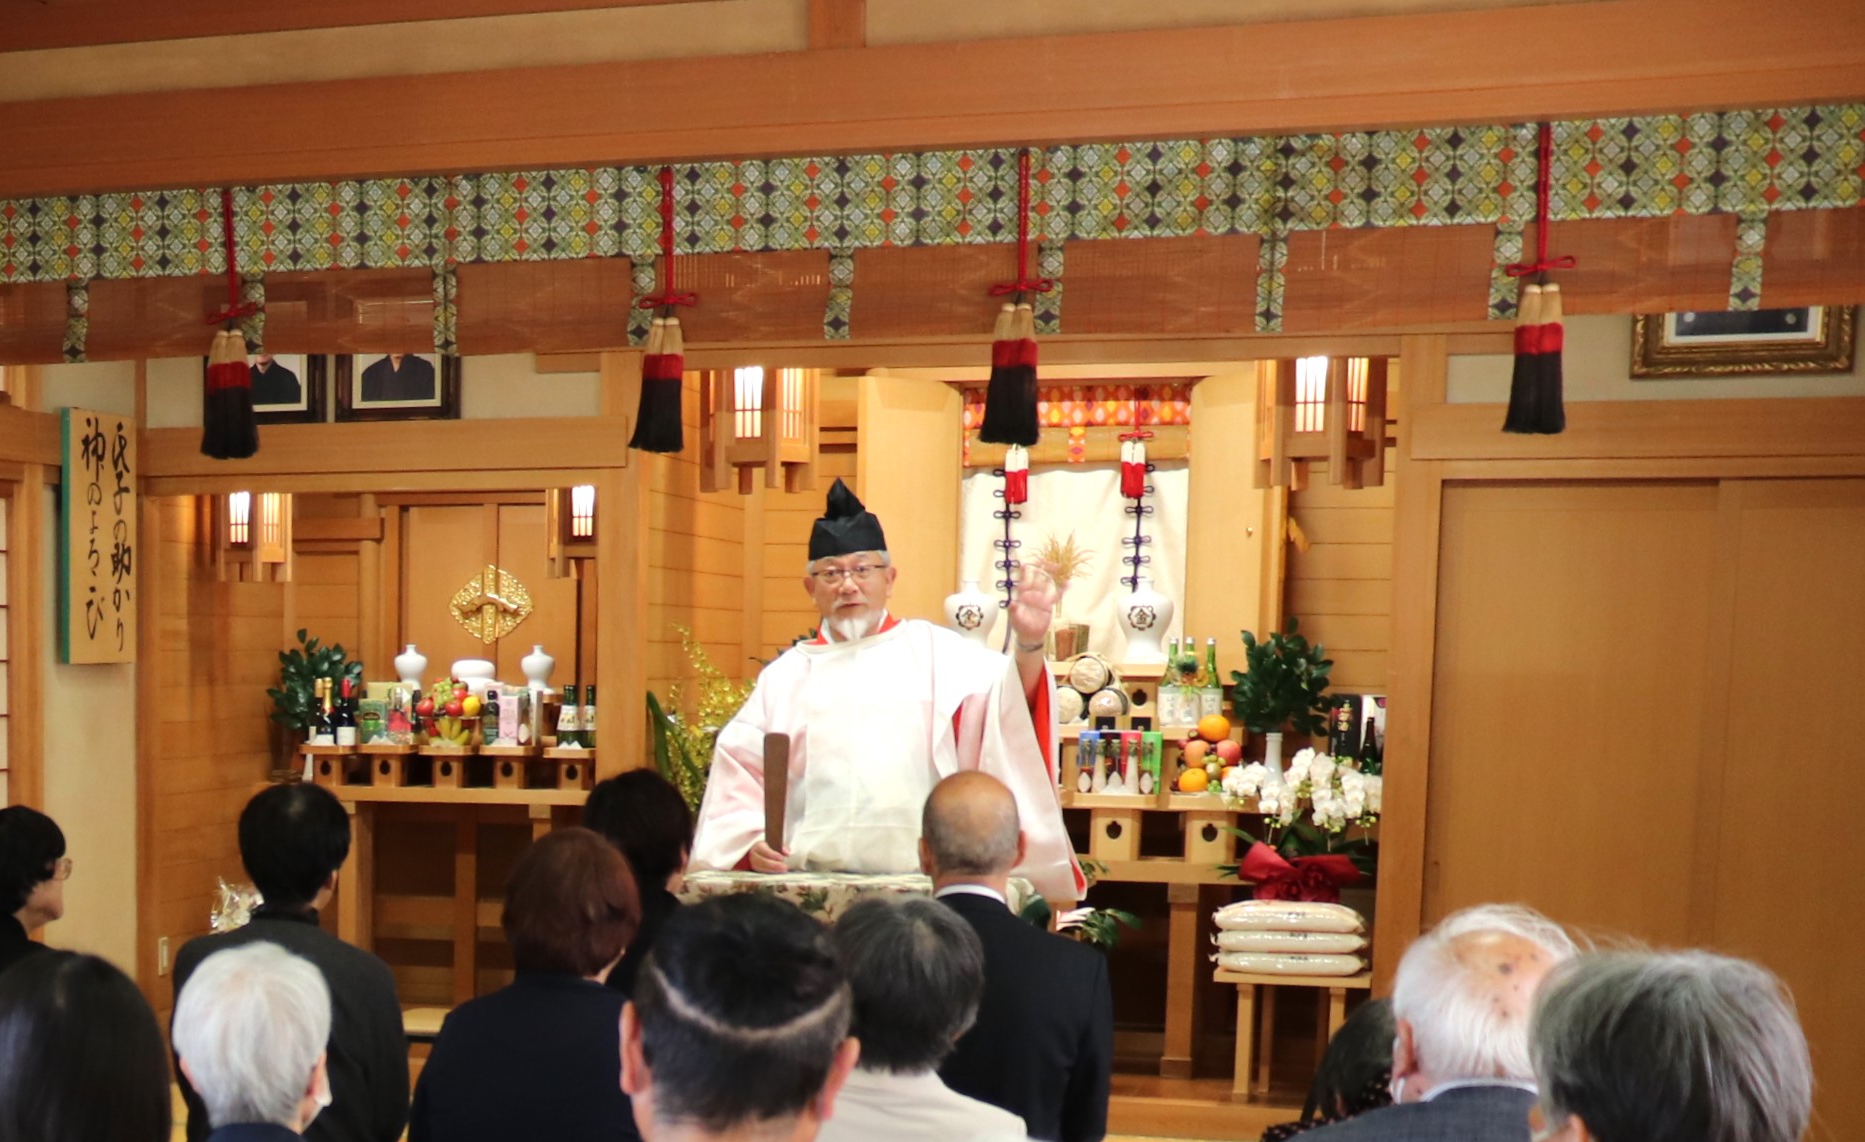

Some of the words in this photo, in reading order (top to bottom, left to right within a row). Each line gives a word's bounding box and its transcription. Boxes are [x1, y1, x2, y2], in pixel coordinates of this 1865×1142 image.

[80, 416, 107, 641] 神のよろこび
[110, 421, 132, 653] 氏子の助かり
